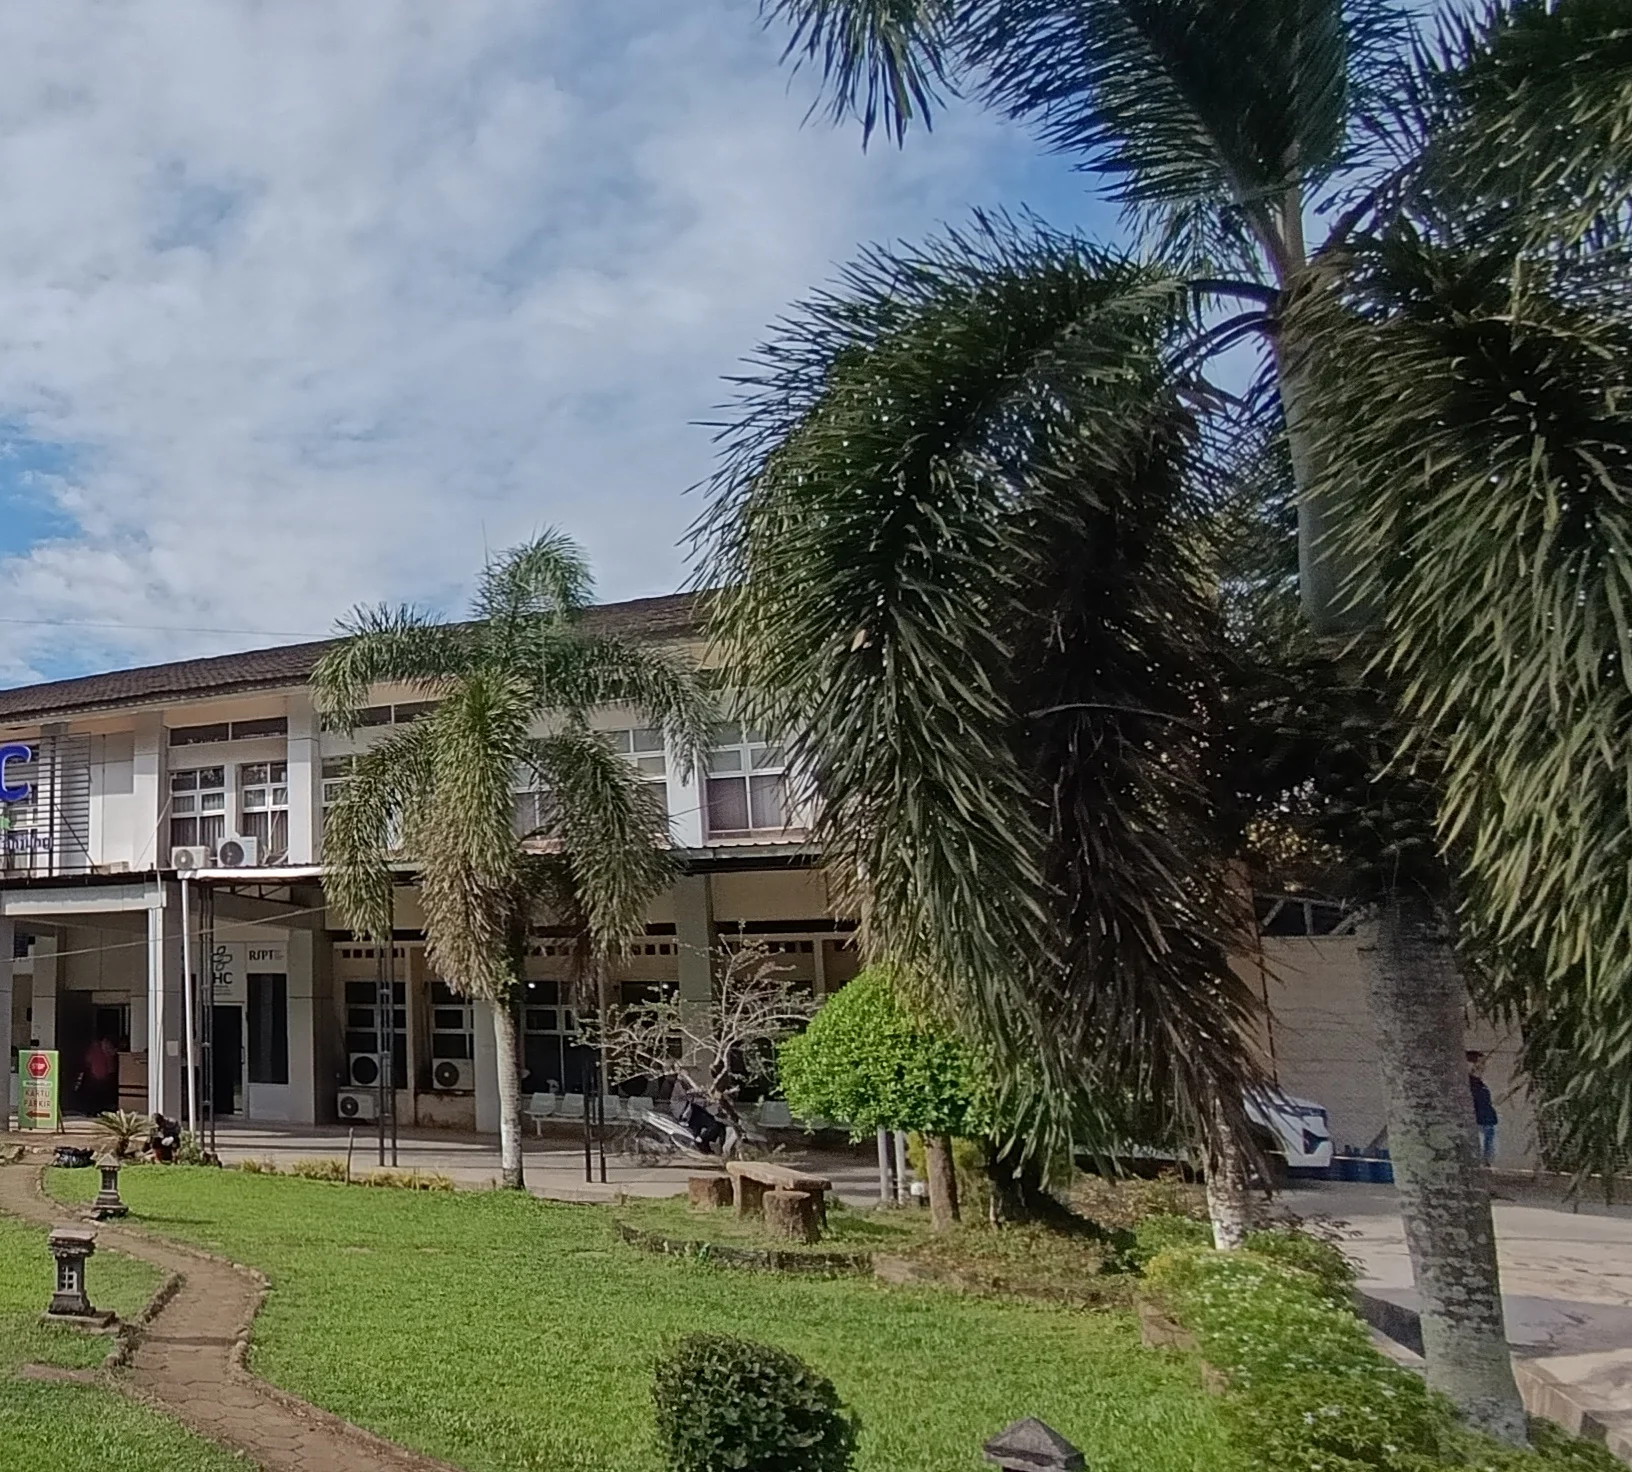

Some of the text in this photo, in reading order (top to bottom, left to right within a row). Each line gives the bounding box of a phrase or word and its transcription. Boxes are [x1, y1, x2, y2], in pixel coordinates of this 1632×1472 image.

[212, 972, 233, 984] HC
[25, 1089, 50, 1098] KARTU
[24, 1099, 51, 1107] PARKIR
